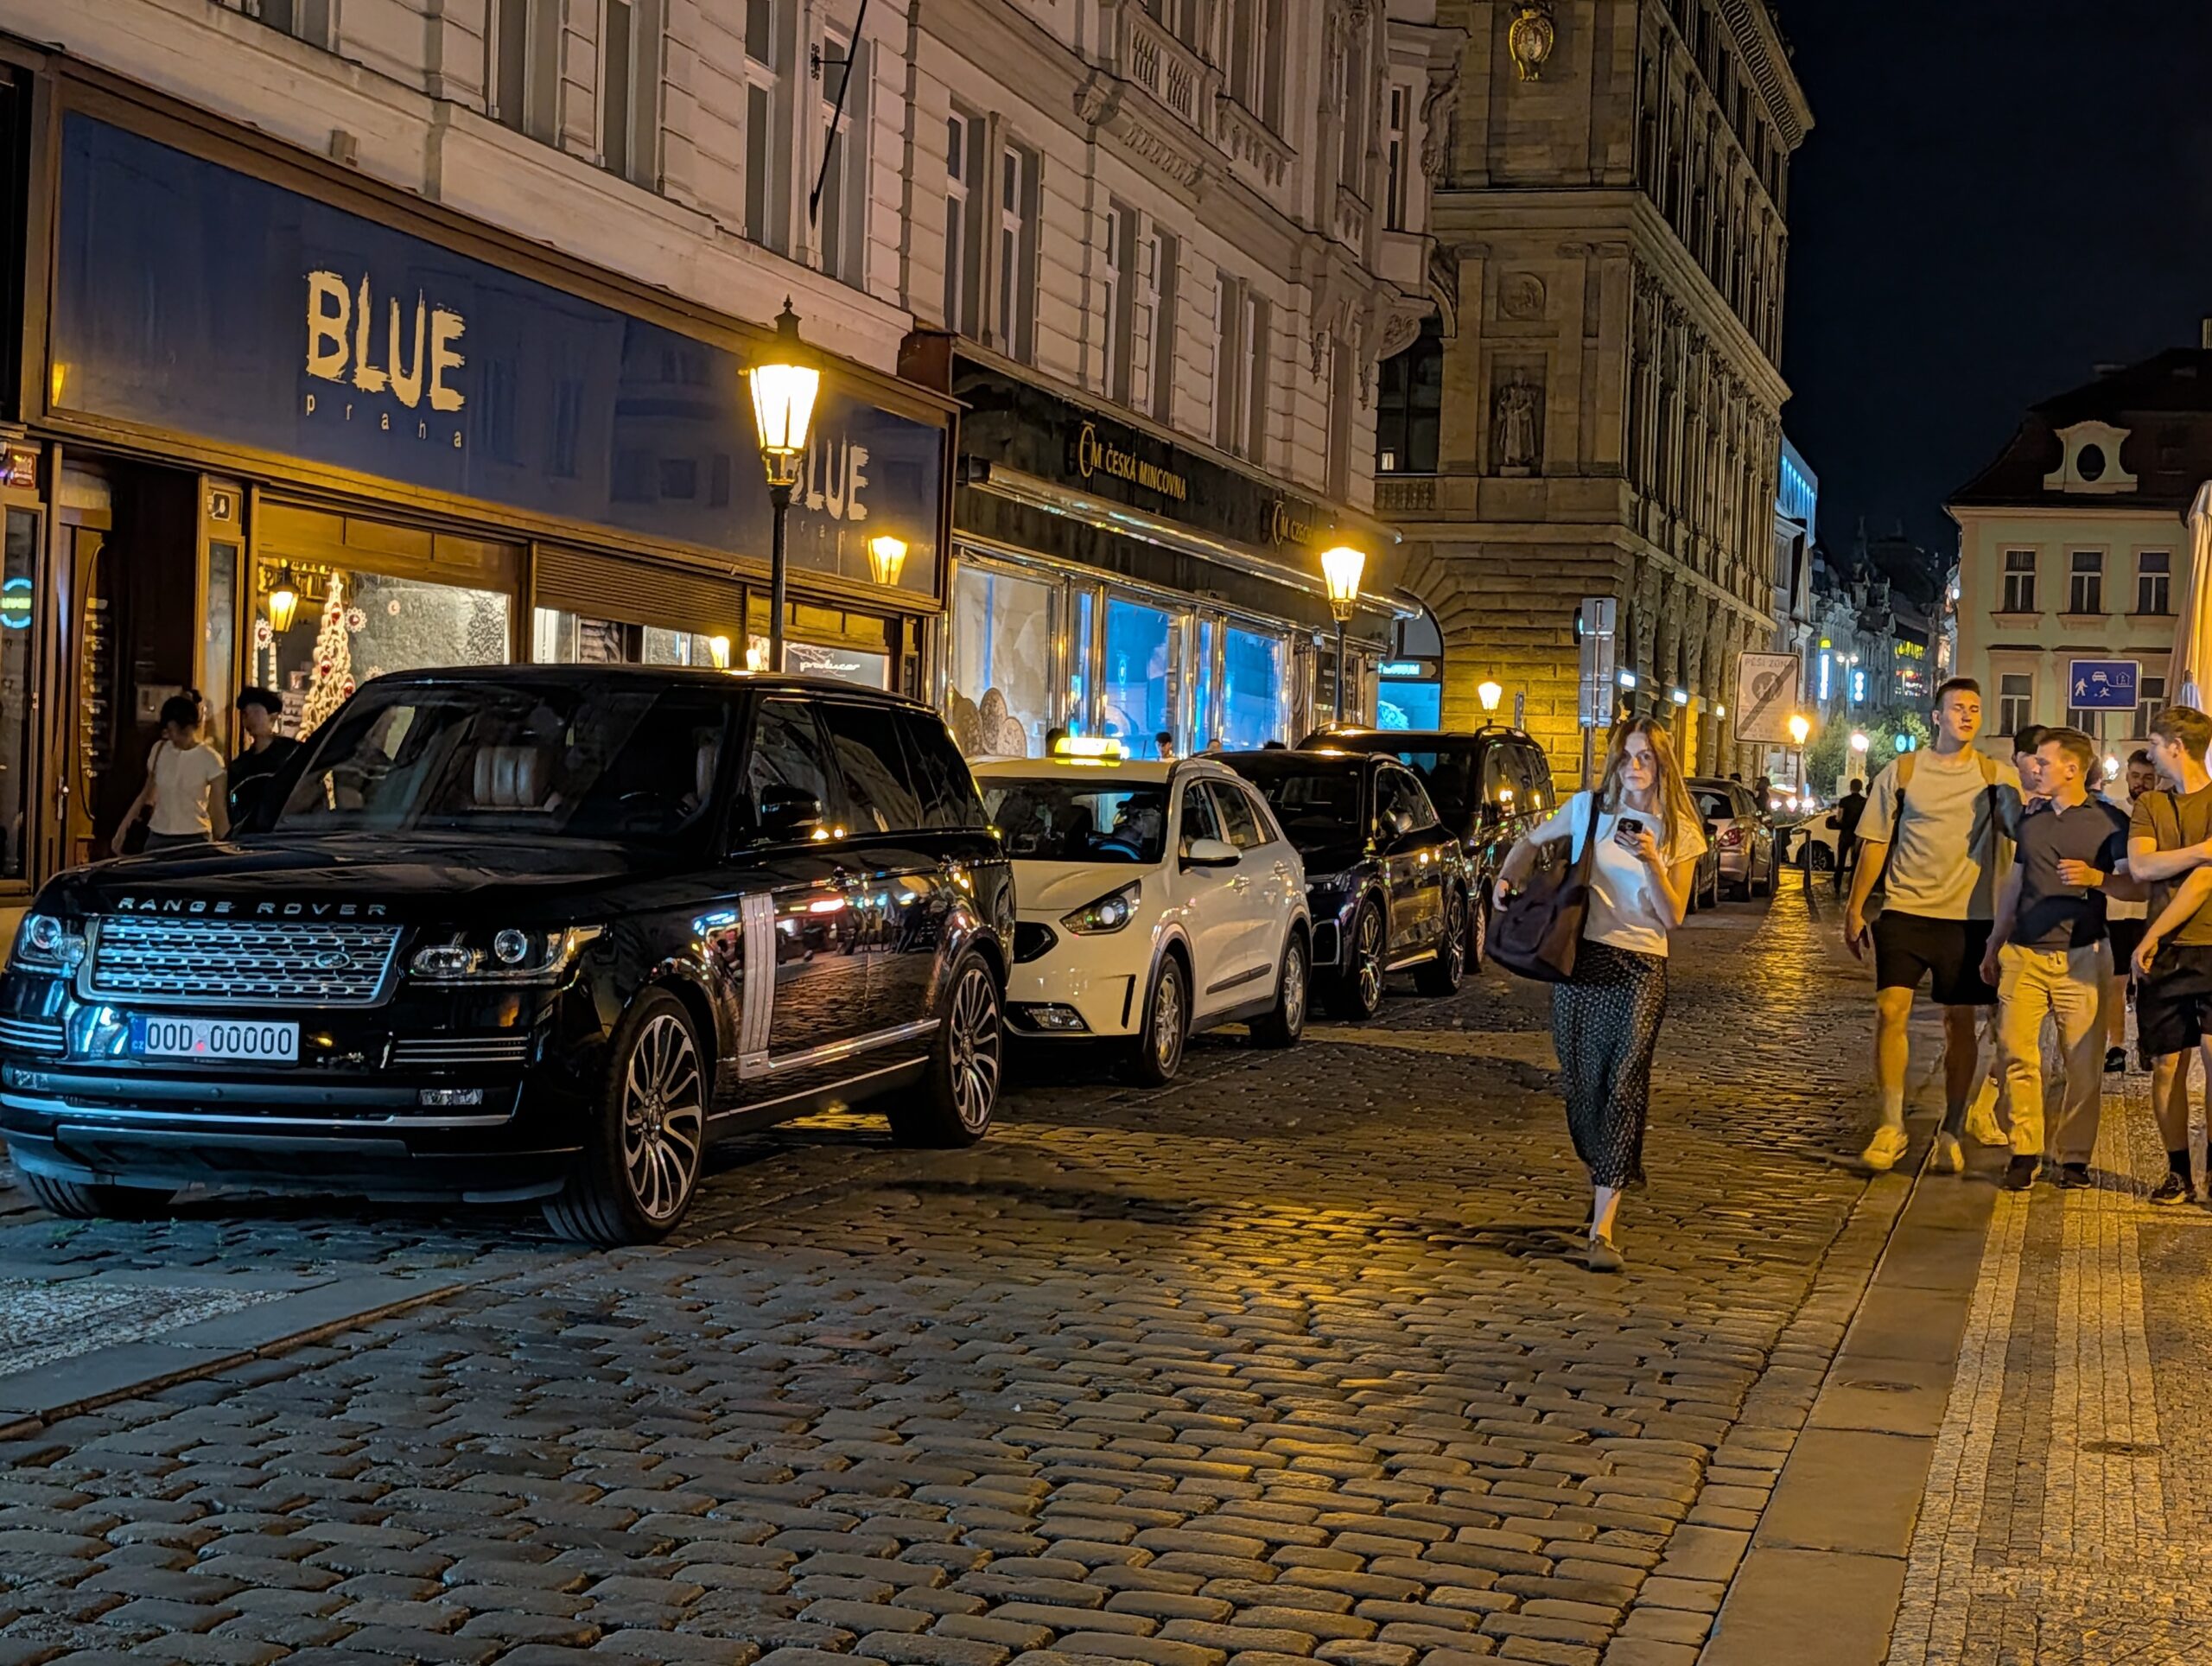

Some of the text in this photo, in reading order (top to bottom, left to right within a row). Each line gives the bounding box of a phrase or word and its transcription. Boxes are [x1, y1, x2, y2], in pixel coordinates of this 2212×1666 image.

[306, 270, 467, 412] BLUE
[306, 394, 462, 448] praha
[1106, 442, 1136, 483] ČESKÁ
[1138, 460, 1186, 501] MINCOVNA
[118, 897, 387, 916] RANGE ROVER
[132, 1040, 144, 1050] CZ
